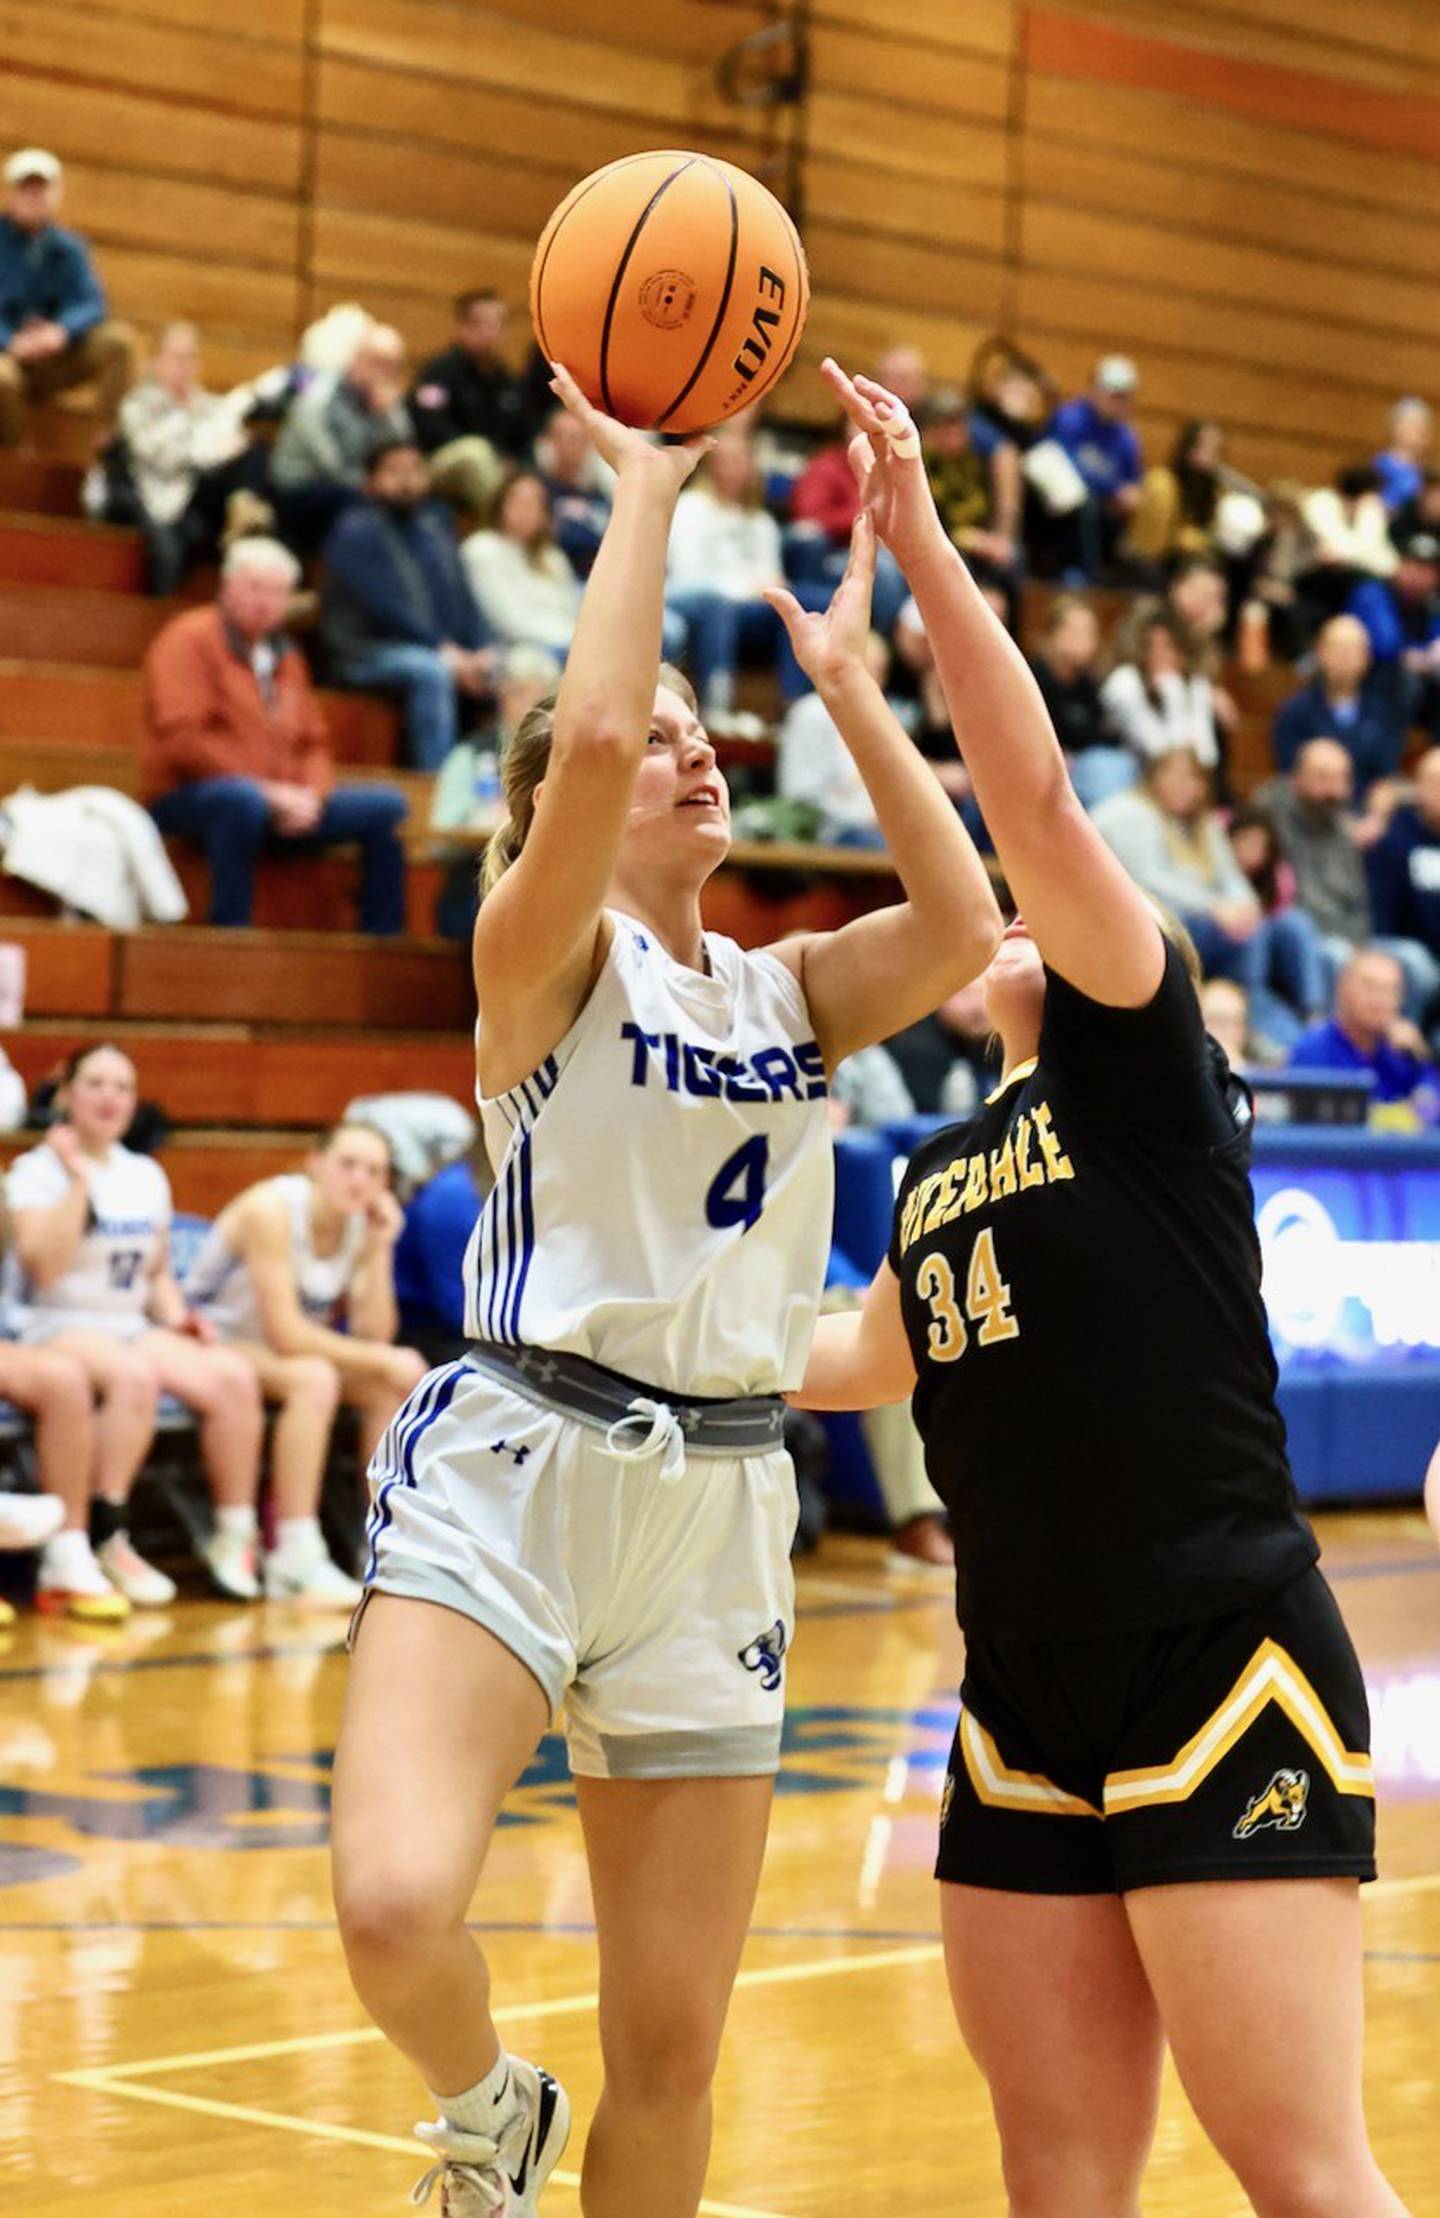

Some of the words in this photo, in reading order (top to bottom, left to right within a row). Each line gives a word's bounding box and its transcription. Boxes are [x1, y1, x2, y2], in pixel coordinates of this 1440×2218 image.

[733, 265, 785, 382] EVO
[620, 1022, 828, 1102] TIGERS
[704, 1133, 769, 1236] 4
[916, 1226, 1020, 1363] 34
